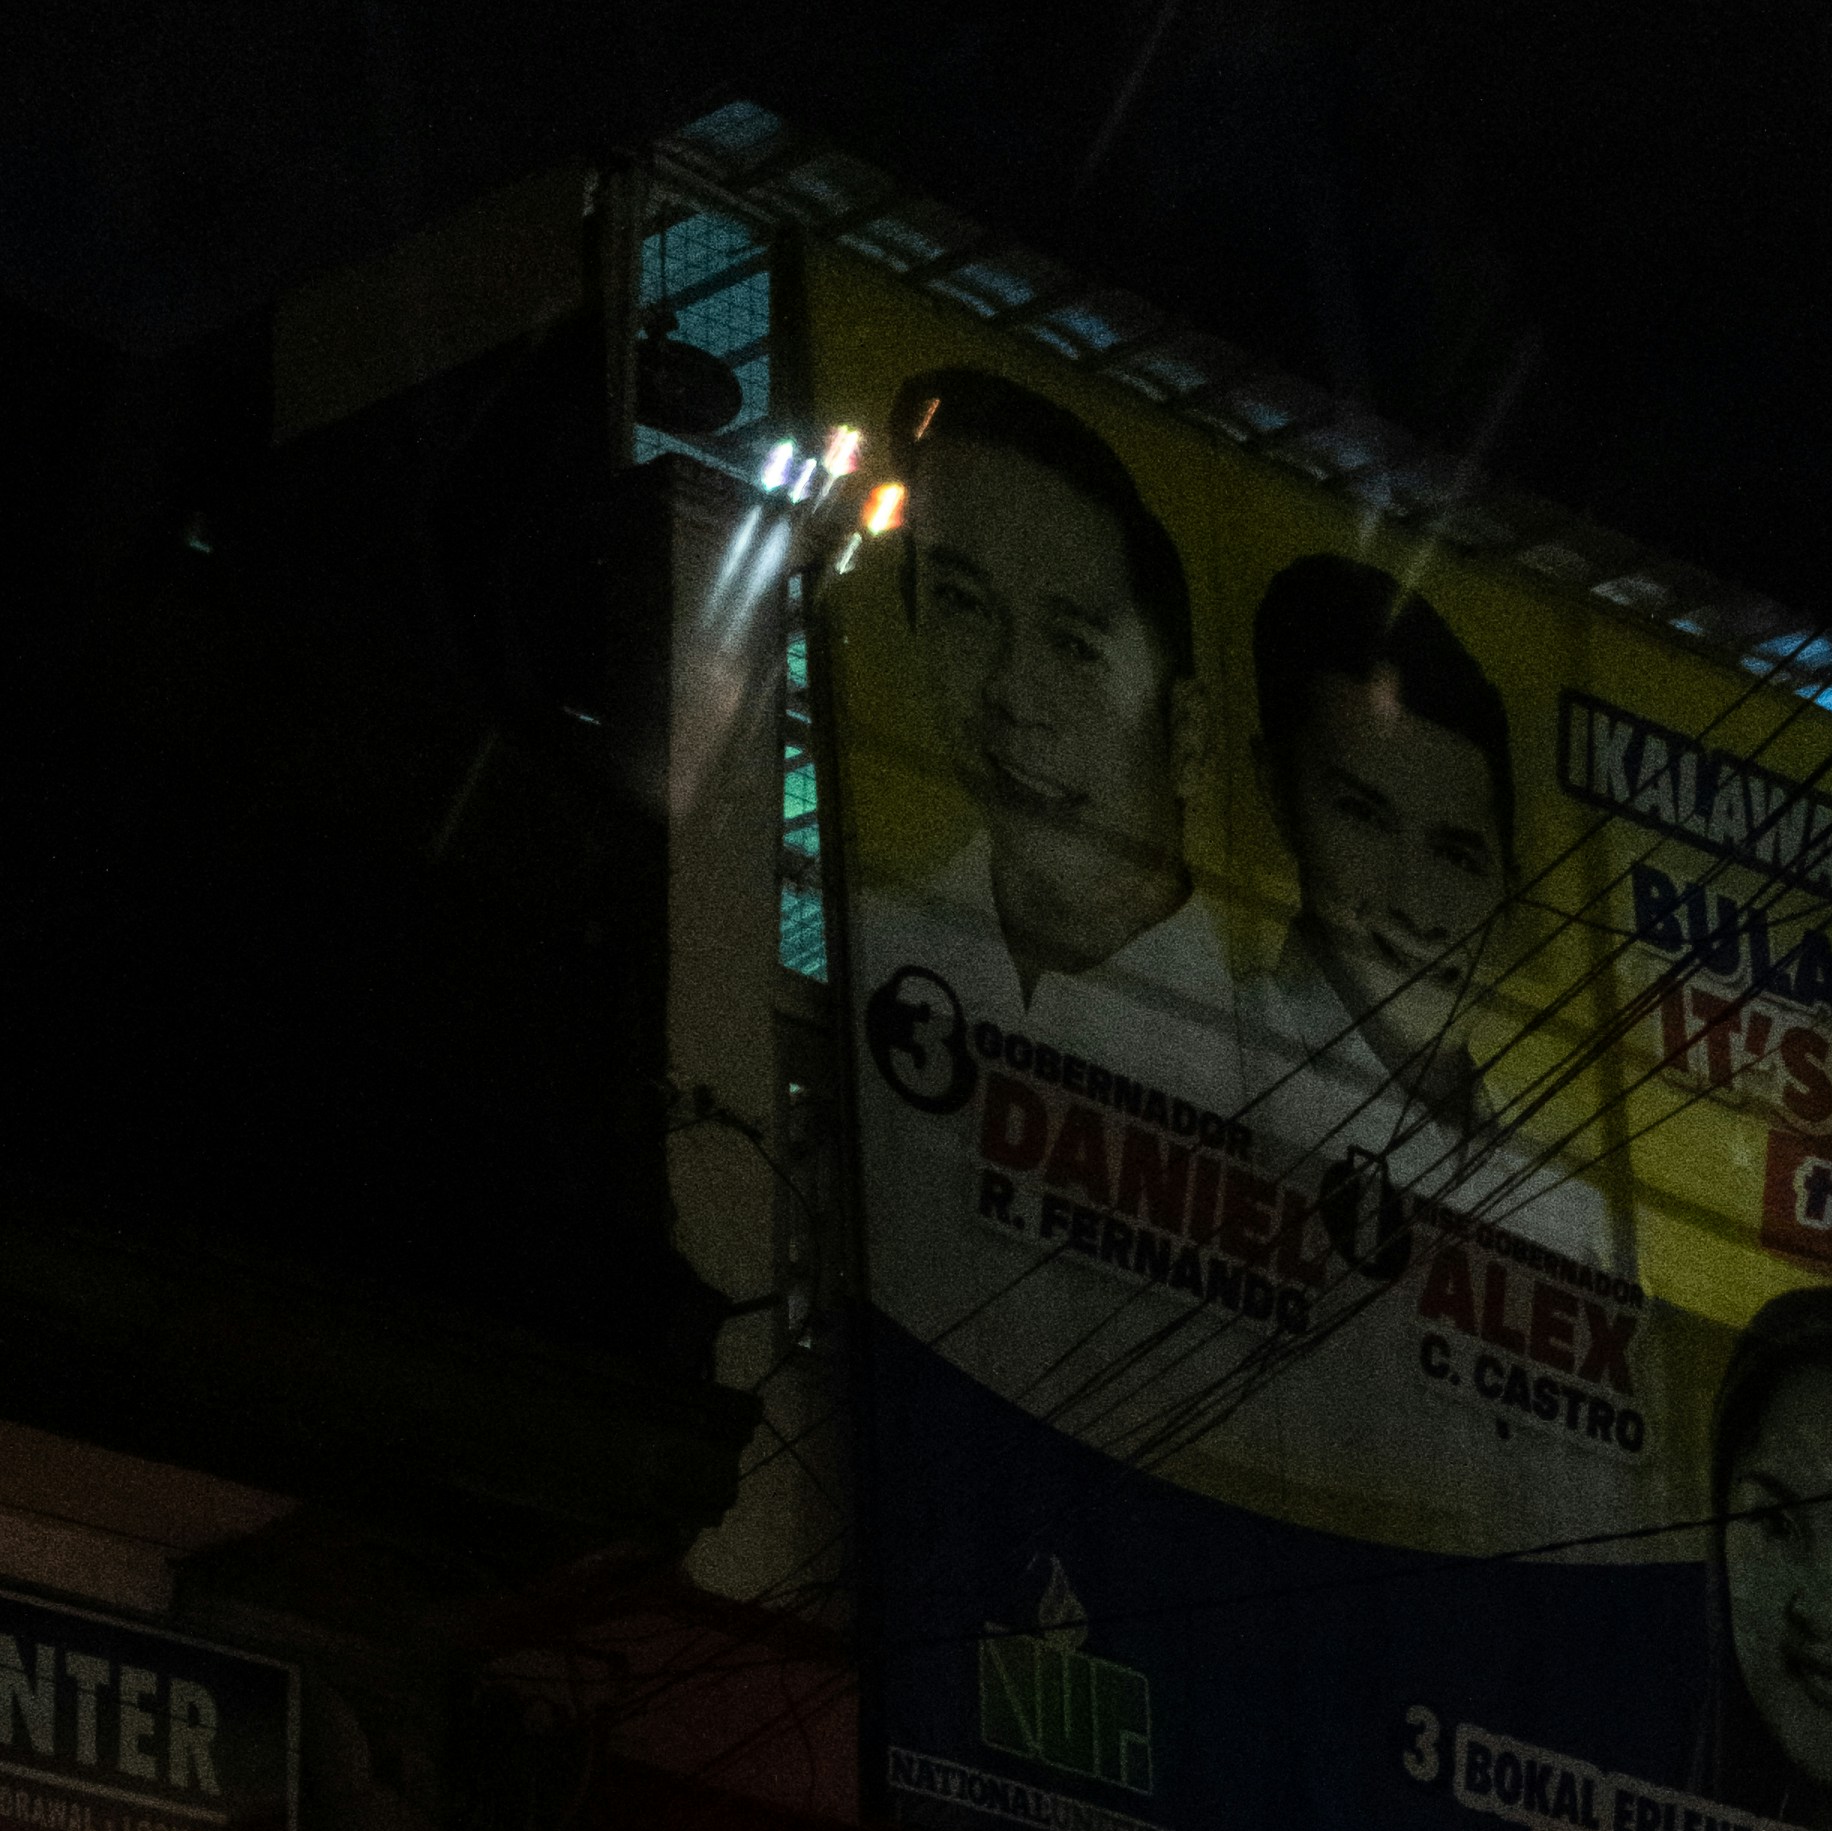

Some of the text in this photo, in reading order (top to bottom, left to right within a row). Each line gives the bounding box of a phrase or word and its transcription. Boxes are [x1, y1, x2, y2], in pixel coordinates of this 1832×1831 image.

[888, 975, 968, 1098] 3
[975, 1020, 1253, 1159] GOBERNADOR
[981, 1074, 1327, 1285] DANIEL
[980, 1169, 1310, 1335] R. FERNANDO
[1476, 1224, 1643, 1308] GOBERNADOR
[1419, 1247, 1637, 1396] ALEX
[1420, 1334, 1643, 1453] C. CASTRO
[892, 1752, 1051, 1826] NATIONAL
[1404, 1706, 1442, 1782] 3
[1465, 1741, 1600, 1827] BOKAL
